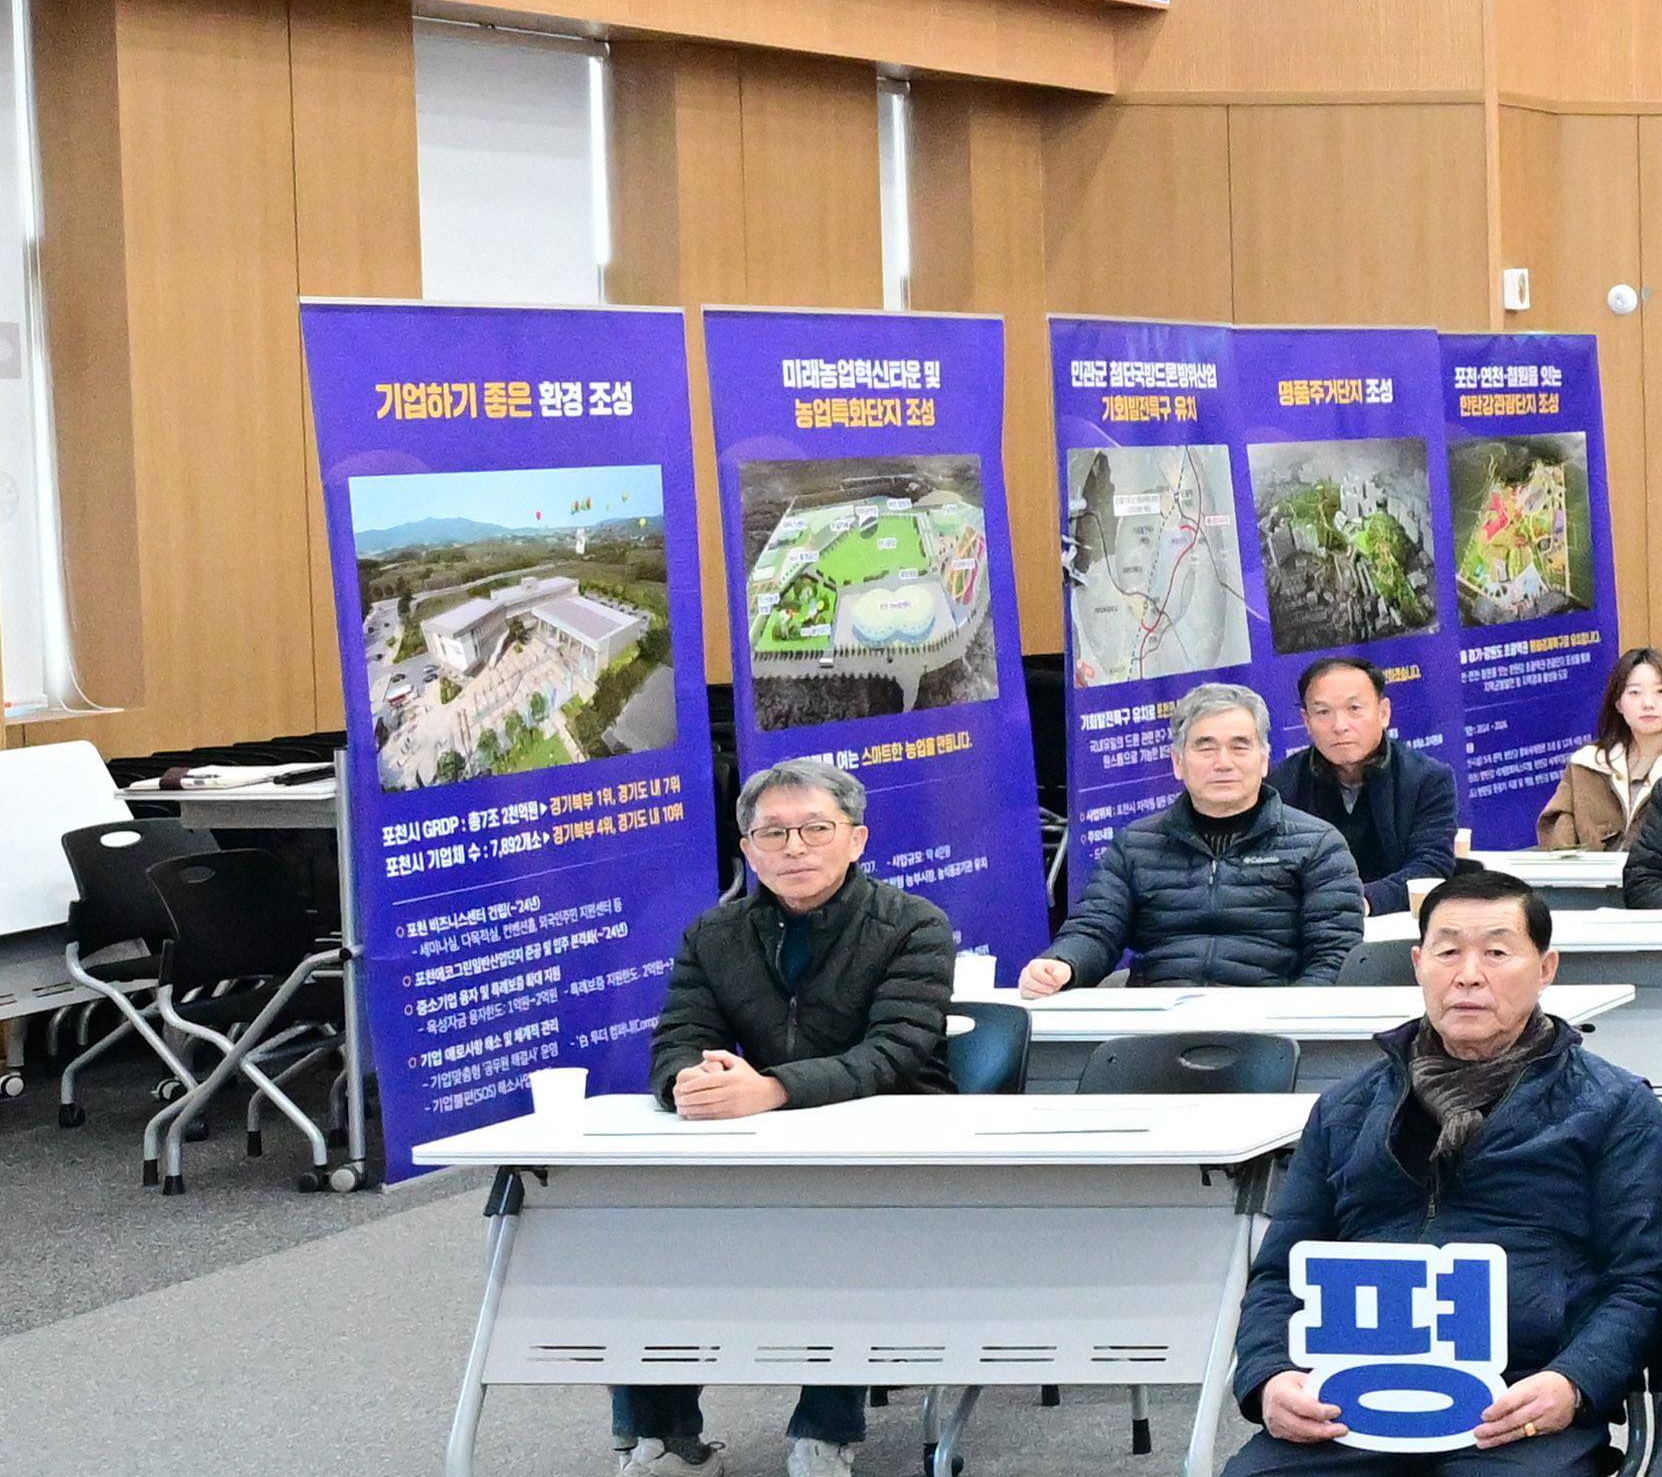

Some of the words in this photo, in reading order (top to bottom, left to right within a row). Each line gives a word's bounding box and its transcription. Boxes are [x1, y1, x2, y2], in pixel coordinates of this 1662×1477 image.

[782, 358, 921, 390] 미래농업혁신타운
[924, 360, 941, 389] 및
[1071, 360, 1107, 389] 민관군
[375, 382, 477, 420] 기업하기
[484, 383, 532, 418] 좋은
[538, 382, 583, 417] 환경
[589, 381, 633, 416] 조성
[1102, 393, 1171, 423] 기회발전특구
[1174, 394, 1197, 421] 유치
[1278, 378, 1362, 406] 명품주거단지
[1365, 378, 1393, 404] 조성
[1539, 393, 1560, 415] 조성
[794, 396, 901, 429] 농업특화단지
[906, 396, 935, 427] 조성
[837, 750, 859, 770] 여는
[862, 742, 903, 766] 스마트한
[382, 821, 420, 848] 포천시
[423, 814, 459, 841] GRDP
[550, 790, 593, 817] 경기북부
[618, 781, 647, 805] 경기도
[650, 779, 661, 799] 내
[663, 775, 680, 797] 7위
[386, 851, 424, 878] 포천시
[427, 843, 465, 870] 기업체
[468, 840, 481, 862] 수
[552, 819, 593, 846] 경기북부
[618, 809, 647, 833] 경기도
[650, 807, 660, 827] 내
[663, 802, 684, 825] 10위
[1304, 1257, 1494, 1440] 평
